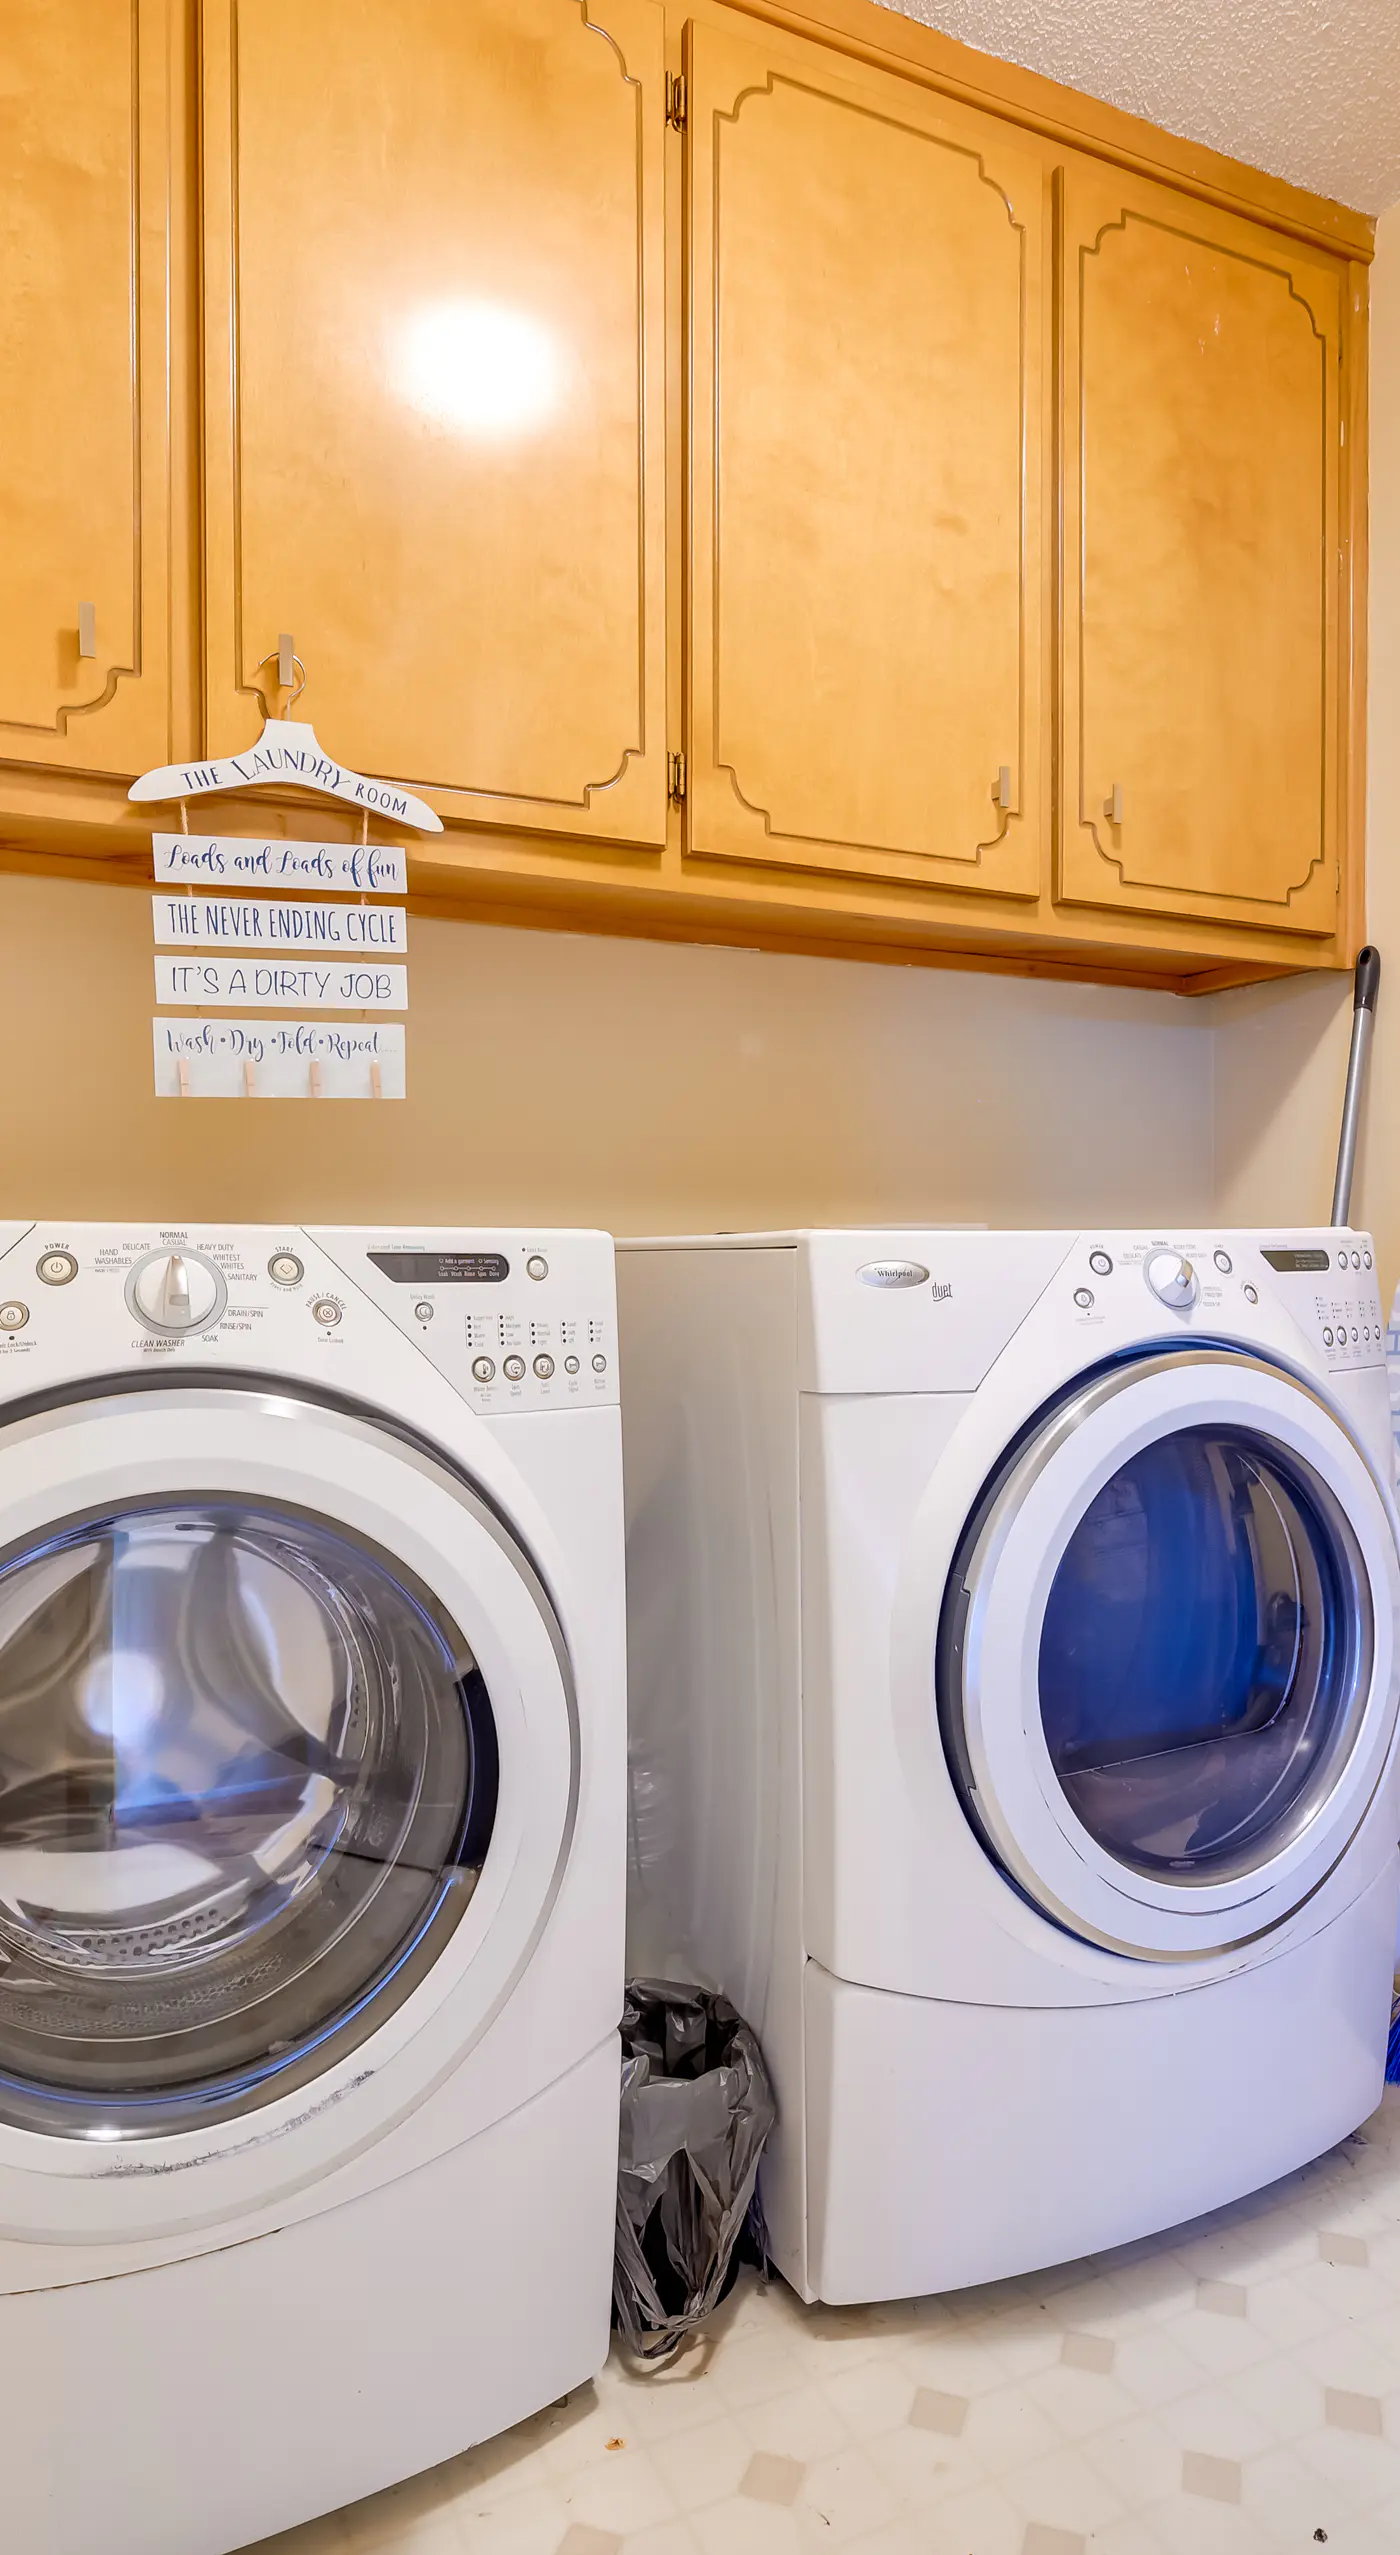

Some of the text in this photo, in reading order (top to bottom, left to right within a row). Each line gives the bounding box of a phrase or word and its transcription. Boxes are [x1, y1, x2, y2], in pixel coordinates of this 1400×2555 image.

[180, 748, 408, 816] THE LAUNDRY ROOM
[164, 843, 399, 889] Loads and Loads of fun
[167, 903, 397, 944] THE NEVER ENDING CYCLE
[172, 966, 392, 999] IT'S A DIRTY JOB
[167, 1024, 215, 1055] Wash
[228, 1028, 264, 1063] Dry
[160, 1231, 188, 1239] NORMAL
[44, 1242, 70, 1250] POWER
[99, 1248, 119, 1256] HAND
[213, 1253, 240, 1261] WHITEST
[220, 1262, 244, 1270] WHITES
[227, 1273, 258, 1281] SANITARY
[877, 1268, 913, 1279] Whirlpool
[931, 1282, 952, 1298] duet
[131, 1339, 185, 1348] CLEAN WASHER
